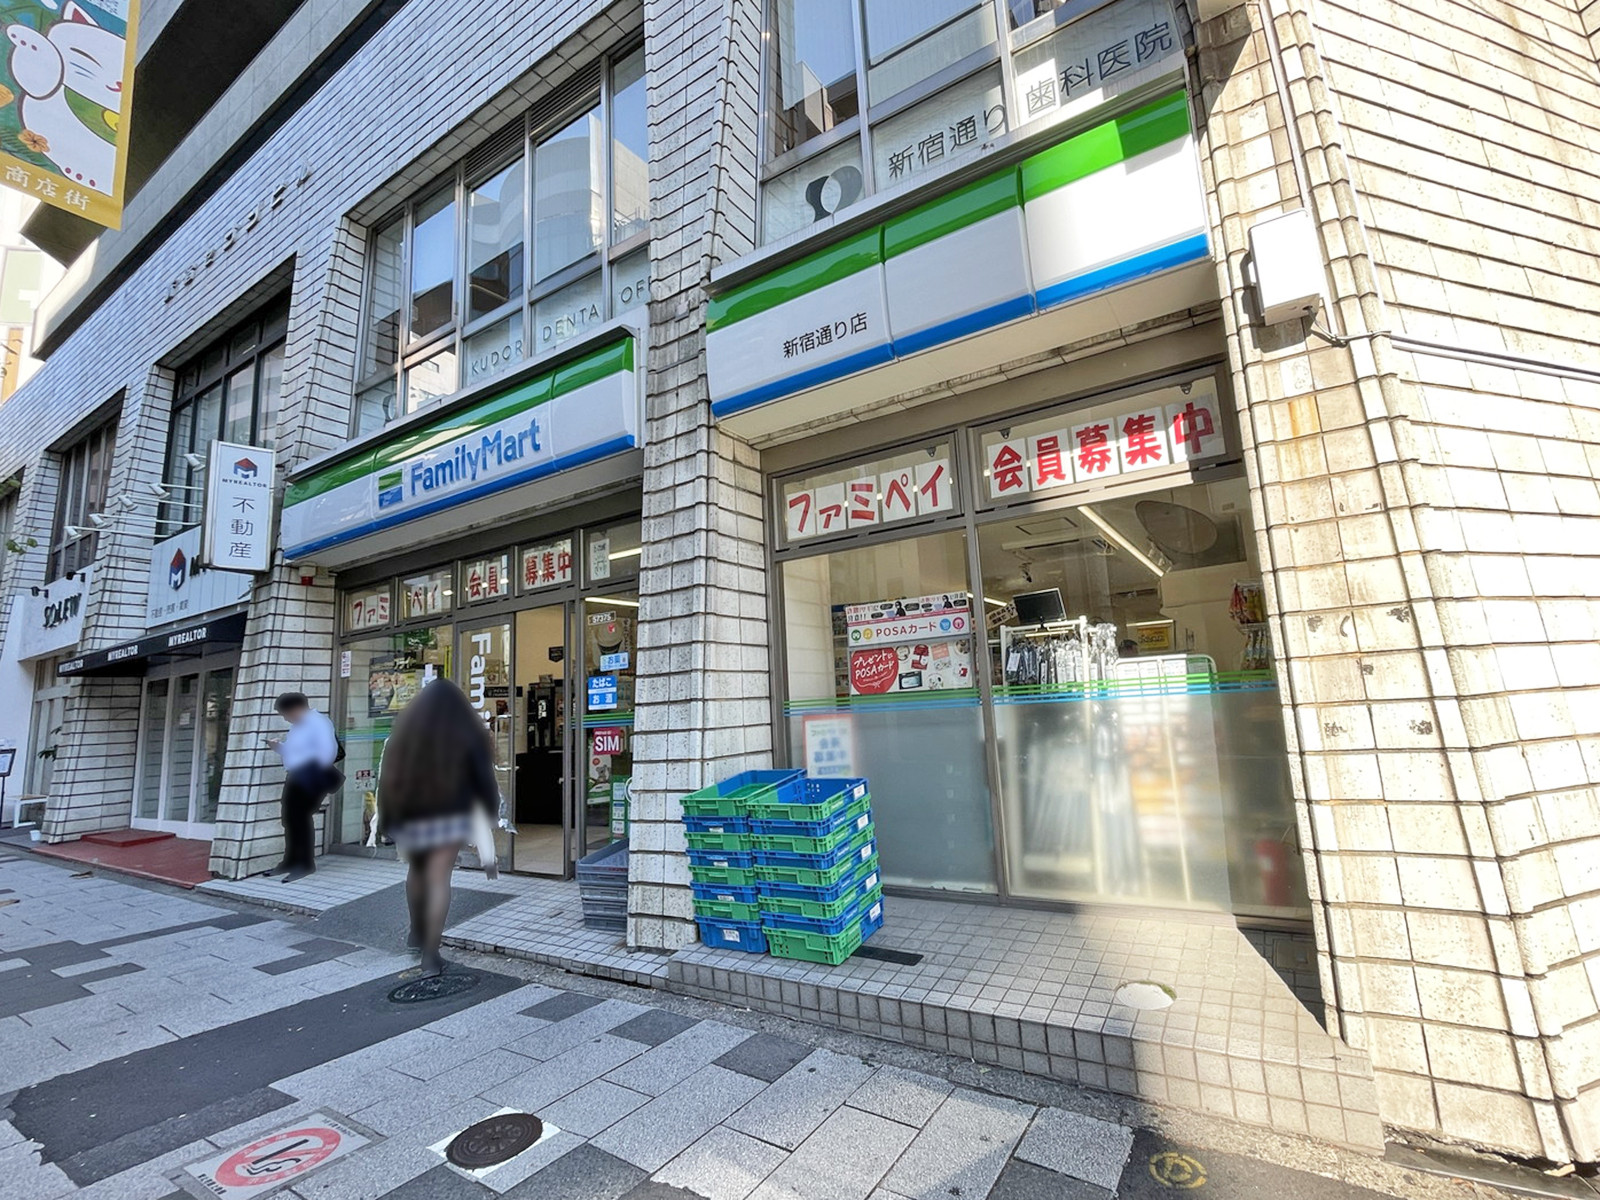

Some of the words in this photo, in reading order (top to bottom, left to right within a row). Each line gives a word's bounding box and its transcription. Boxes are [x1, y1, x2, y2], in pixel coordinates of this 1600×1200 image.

[5, 165, 90, 211] 商店街
[782, 312, 868, 359] 新宿通り店
[411, 417, 541, 496] FamilyMart
[788, 464, 944, 533] ファミペイ
[993, 402, 1215, 491] 会員募集中
[221, 478, 268, 488] MYREALTOR
[228, 496, 255, 559] 不動産
[168, 627, 207, 647] MYREALTOR
[876, 621, 937, 637] POSAカード
[107, 645, 138, 661] MYREALTOR
[855, 660, 895, 680] POSAカード
[592, 677, 612, 688] たばこ
[595, 735, 619, 751] SIM
